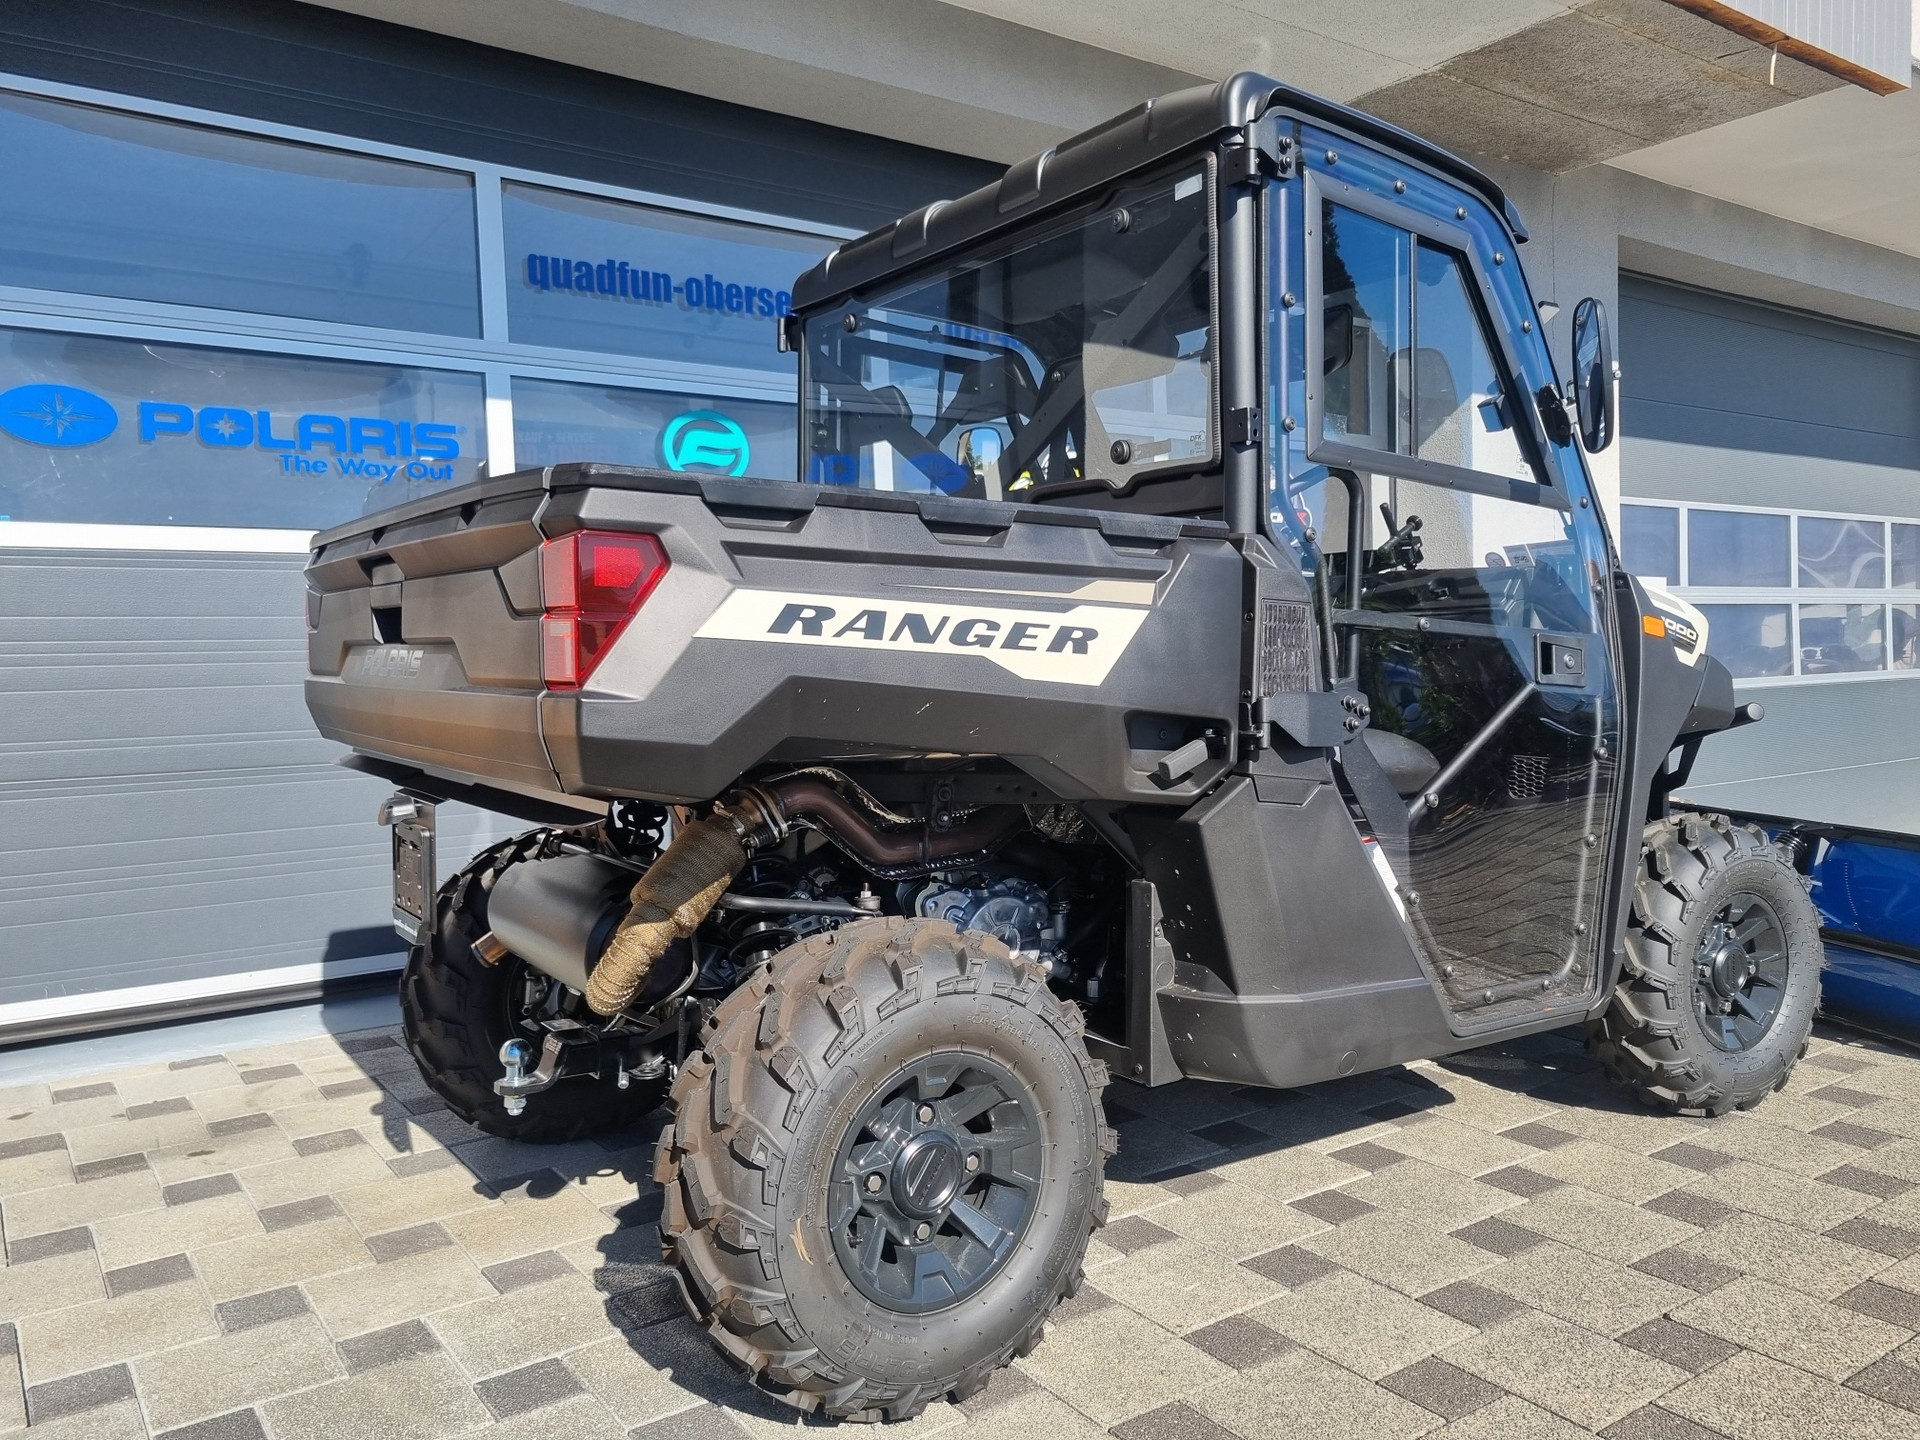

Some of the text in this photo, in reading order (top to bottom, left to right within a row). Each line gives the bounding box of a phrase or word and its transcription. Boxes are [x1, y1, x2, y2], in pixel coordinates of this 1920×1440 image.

[526, 252, 794, 317] quadfun-oberse
[140, 400, 460, 459] POLARIS
[279, 453, 454, 484] The Way Out
[766, 603, 1100, 655] RANGER
[361, 648, 425, 679] POLARIS
